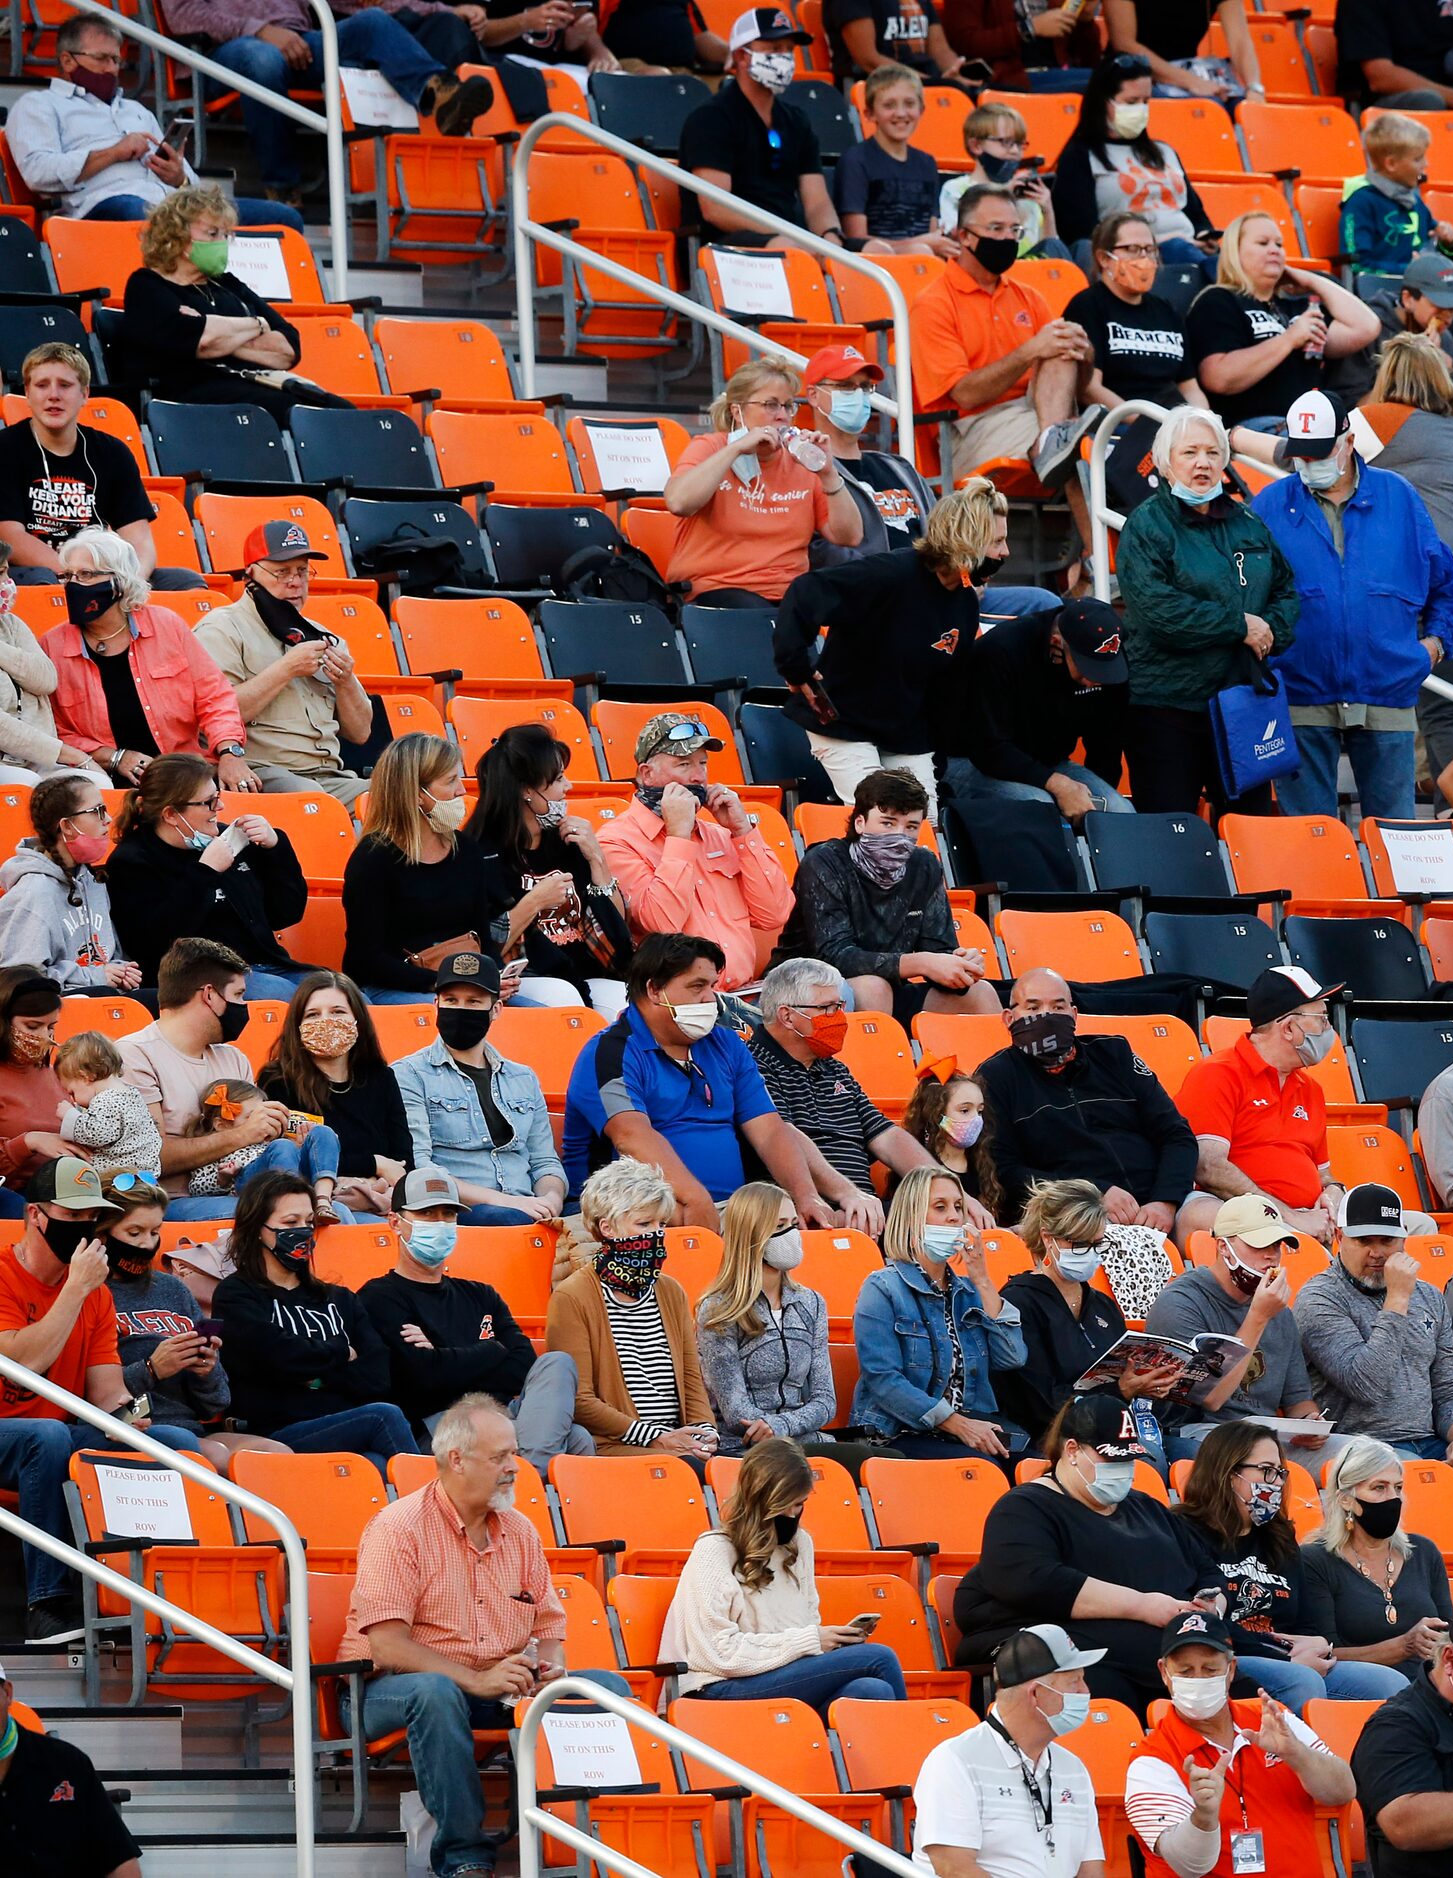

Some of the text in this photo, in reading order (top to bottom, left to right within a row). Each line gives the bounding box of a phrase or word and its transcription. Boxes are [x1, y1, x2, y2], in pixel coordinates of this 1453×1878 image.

[42, 316, 56, 326] 15
[237, 415, 249, 425] 15
[379, 420, 392, 430] 16
[1299, 413, 1316, 433] T
[42, 478, 86, 495] PLEASE
[290, 507, 304, 517] 14
[770, 505, 790, 514] time
[433, 513, 446, 523] 15
[52, 597, 63, 606] 11
[198, 602, 211, 611] 12
[343, 607, 356, 617] 13
[488, 610, 500, 619] 14
[629, 614, 642, 624] 15
[399, 706, 412, 716] 12
[543, 710, 555, 721] 13
[1254, 737, 1286, 756] PENTEGRA
[303, 803, 319, 814] 10
[1172, 823, 1185, 833] 16
[1387, 833, 1414, 842] PLEASE
[1415, 834, 1426, 842] DO
[1424, 856, 1444, 864] THIS
[1090, 923, 1103, 932] 14
[1234, 926, 1247, 936] 15
[1373, 929, 1387, 939] 16
[112, 1009, 121, 1019] 6
[265, 1012, 273, 1022] 7
[417, 1016, 426, 1026] 8
[570, 1018, 579, 1028] 9
[864, 1024, 875, 1033] 11
[1154, 1027, 1167, 1037] 13
[1440, 1033, 1453, 1043] 15
[1365, 1137, 1378, 1147] 13
[378, 1236, 387, 1246] 5
[534, 1238, 542, 1247] 6
[616, 1240, 651, 1251] GOOD
[687, 1239, 694, 1249] 7
[642, 1249, 654, 1259] IS
[1431, 1247, 1444, 1256] 12
[615, 1255, 649, 1268] GOOD
[607, 1260, 634, 1281] GOO
[640, 1267, 651, 1276] IS
[105, 1470, 173, 1482] PLEASE DO NOT
[965, 1469, 974, 1481] 6
[116, 1496, 169, 1507] SIT ON THIS
[135, 1522, 157, 1531] ROW
[558, 1588, 567, 1598] 2
[71, 1655, 80, 1666] 9
[549, 1719, 580, 1728] PLEASE
[597, 1719, 617, 1727] NOT
[592, 1745, 615, 1753] THIS
[583, 1771, 604, 1779] ROW
